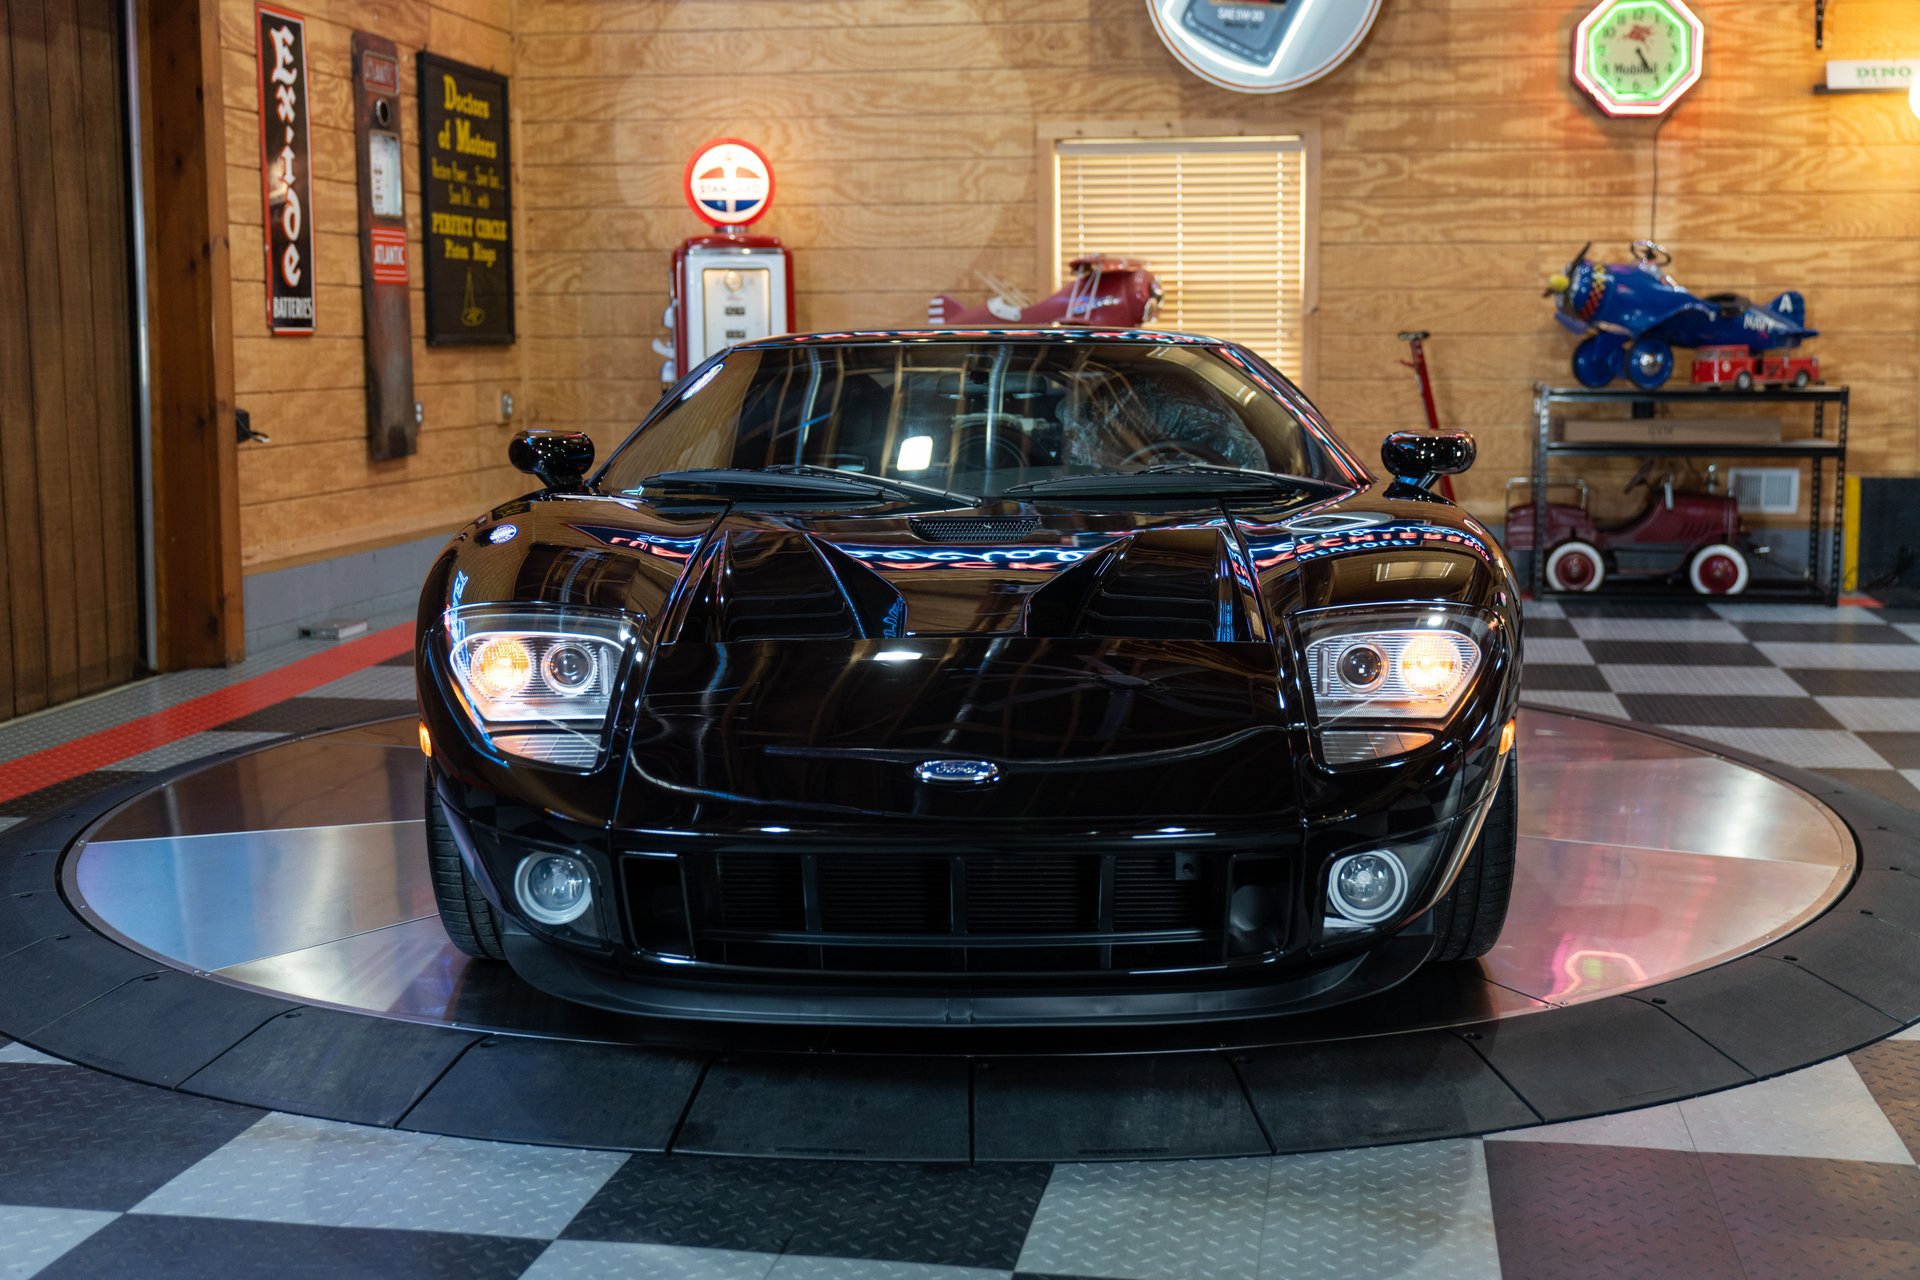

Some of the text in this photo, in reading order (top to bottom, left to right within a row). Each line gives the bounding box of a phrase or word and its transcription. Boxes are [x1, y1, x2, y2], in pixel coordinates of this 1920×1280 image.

[1856, 66, 1912, 78] DINO
[443, 73, 489, 119] Doctors
[438, 117, 497, 159] of Motors
[431, 212, 508, 242] PERFECT CIRCLE
[374, 244, 405, 265] ATLANTIC
[273, 296, 312, 319] BATTERIES
[1778, 294, 1793, 314] A
[1743, 315, 1775, 334] NAVY
[936, 761, 977, 774] Ford
